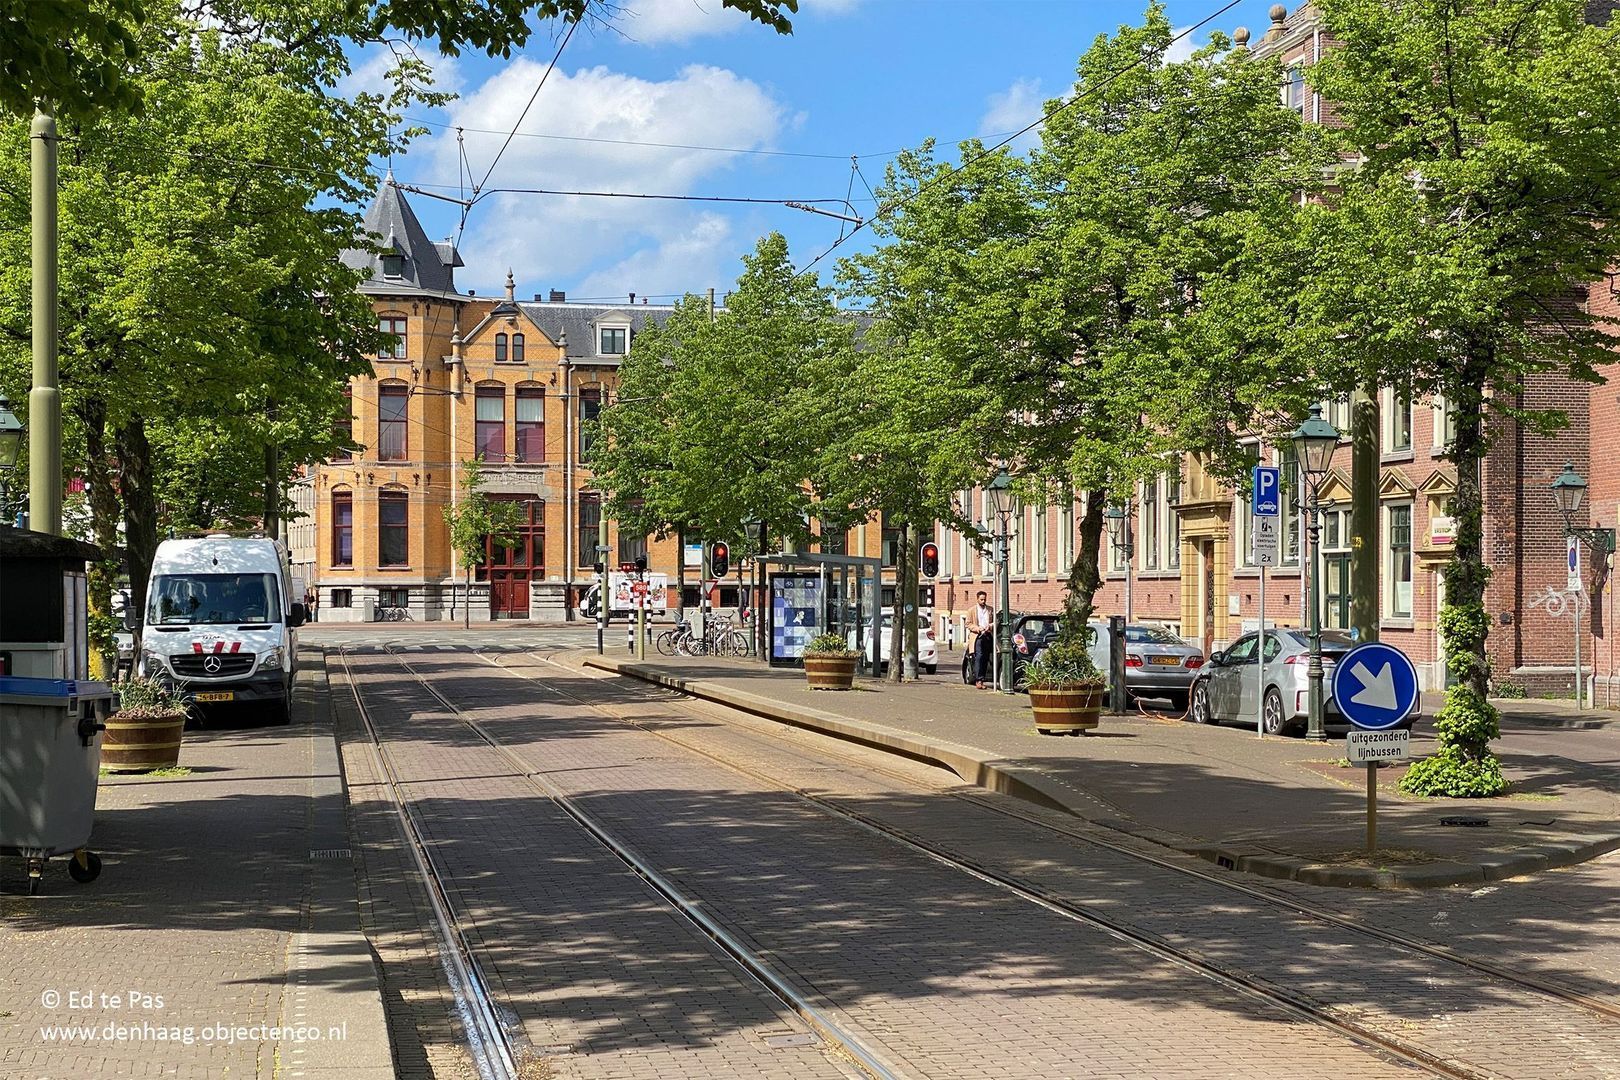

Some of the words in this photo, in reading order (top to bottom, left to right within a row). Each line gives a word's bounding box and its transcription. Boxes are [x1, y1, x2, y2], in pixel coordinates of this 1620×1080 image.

[1260, 471, 1275, 496] P
[1261, 554, 1272, 563] 2x
[1351, 731, 1408, 746] uitgezonderd
[1358, 747, 1402, 760] lijnbussen
